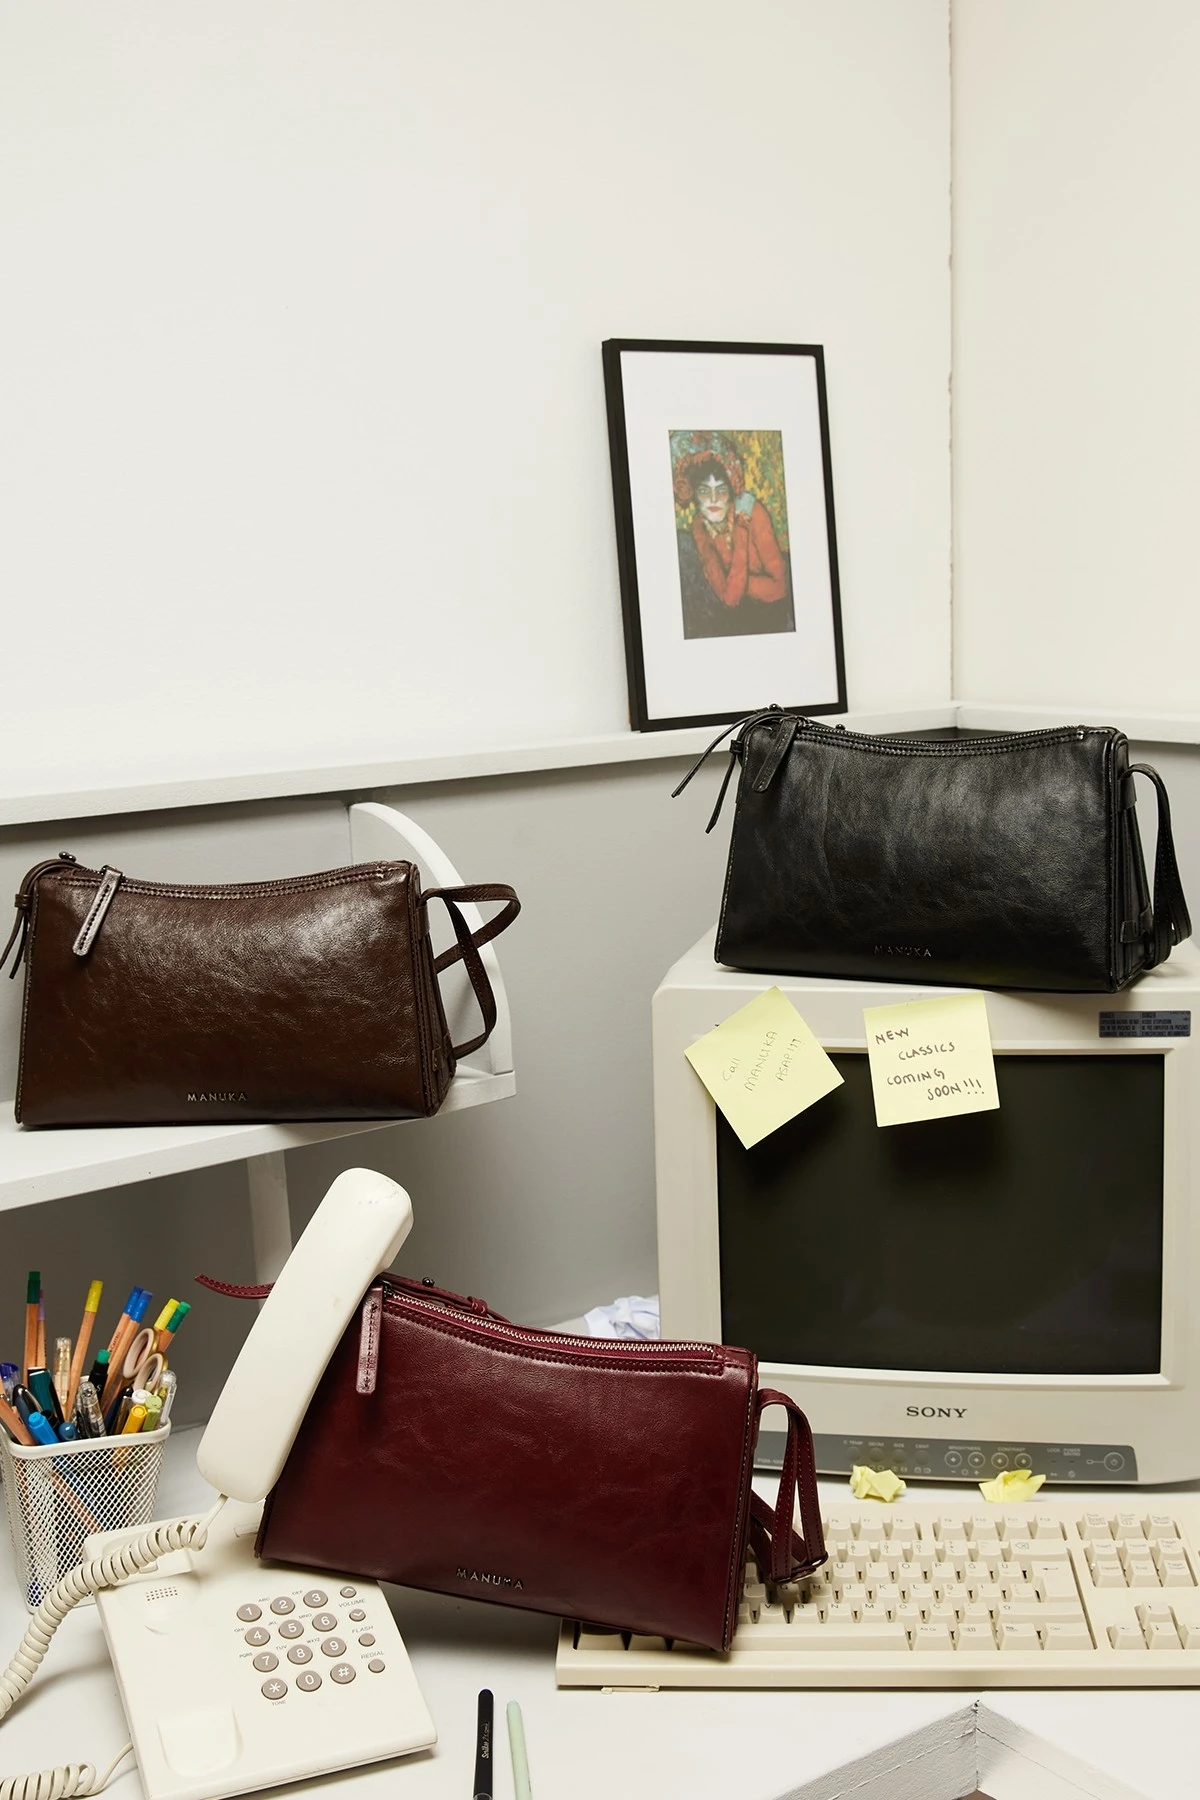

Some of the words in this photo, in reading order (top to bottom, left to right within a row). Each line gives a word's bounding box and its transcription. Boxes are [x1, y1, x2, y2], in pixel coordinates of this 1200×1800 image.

[875, 1027, 909, 1045] NEW
[898, 1041, 956, 1061] CLASSICS
[743, 1030, 778, 1092] MANUKA
[722, 1057, 741, 1082] Call
[886, 1068, 946, 1086] COMING
[927, 1078, 985, 1101] SOON!!!
[187, 1092, 247, 1102] MANUKA
[906, 1405, 968, 1419] SONY
[456, 1568, 523, 1590] MANUKA
[311, 1593, 321, 1602] 3
[339, 1598, 366, 1608] VOLUME
[278, 1599, 288, 1609] 2
[246, 1606, 253, 1616] 1
[321, 1616, 330, 1626] 6
[287, 1623, 297, 1633] 5
[352, 1625, 374, 1634] FLASH
[253, 1630, 262, 1640] 4
[329, 1640, 339, 1651] 9
[296, 1648, 306, 1659] 8
[361, 1651, 385, 1660] REDIAL
[261, 1655, 270, 1666] 7
[305, 1674, 314, 1685] 0
